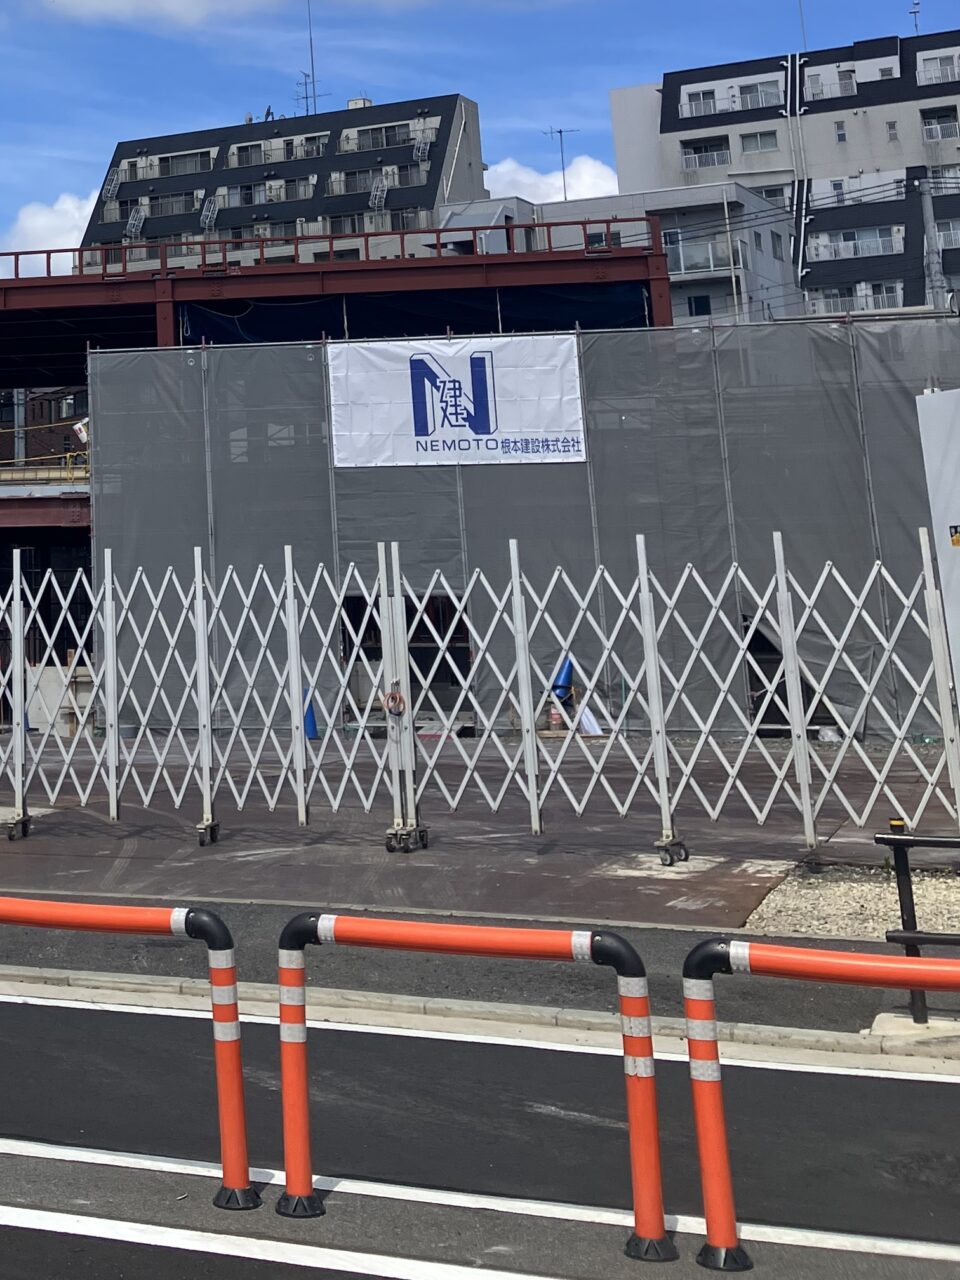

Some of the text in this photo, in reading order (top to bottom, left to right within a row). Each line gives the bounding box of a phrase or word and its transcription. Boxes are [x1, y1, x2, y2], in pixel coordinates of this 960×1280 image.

[409, 351, 498, 437] N
[440, 379, 467, 428] 建
[416, 438, 499, 452] NEMOTO
[501, 436, 582, 455] 根本建設株式会社
